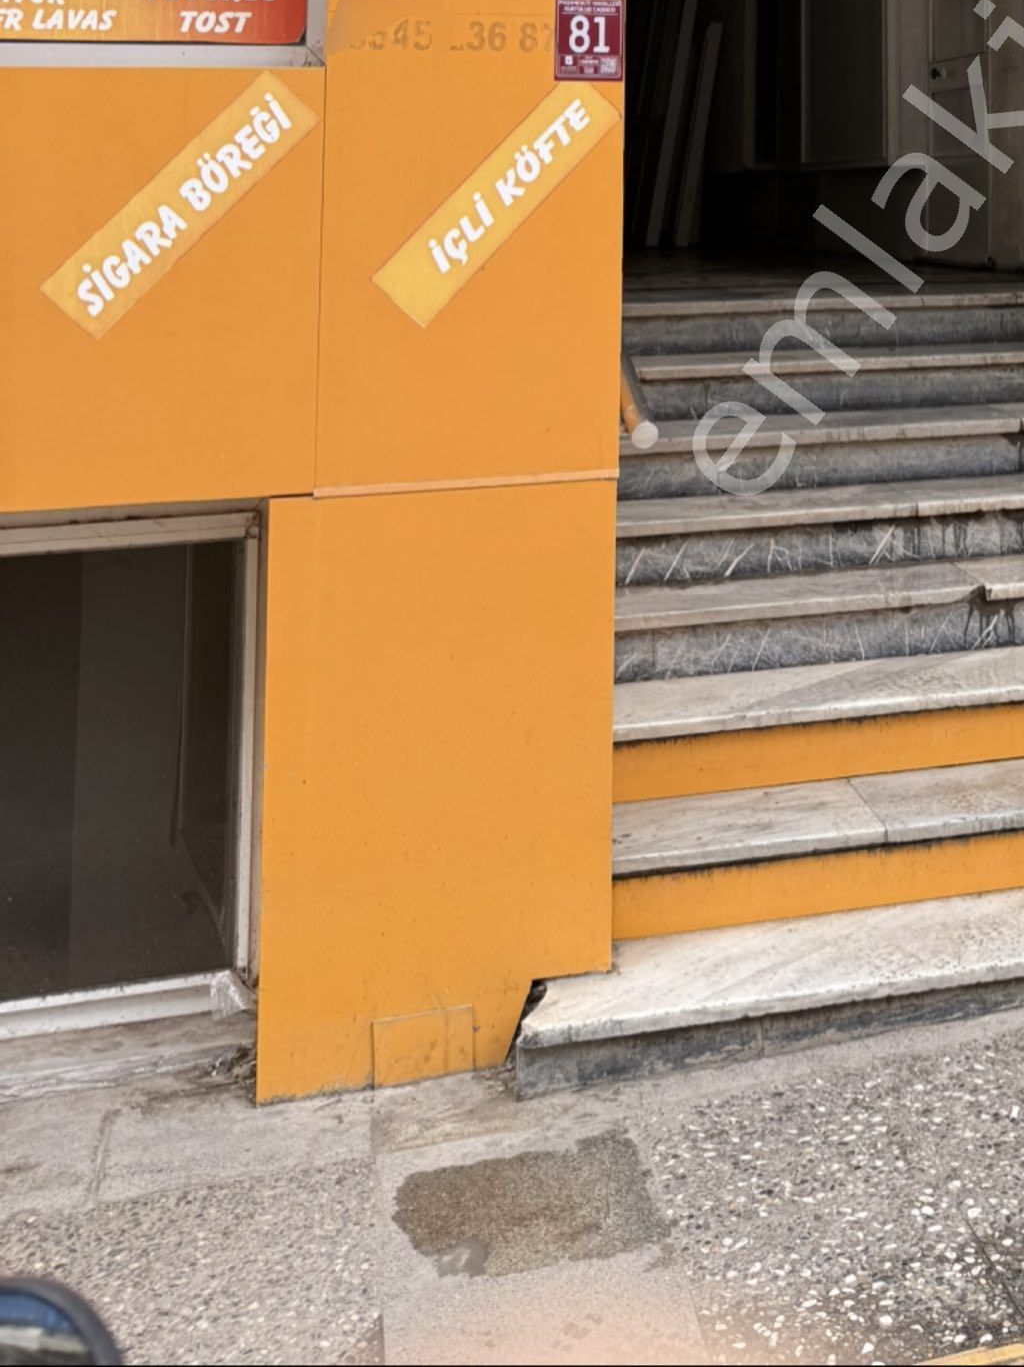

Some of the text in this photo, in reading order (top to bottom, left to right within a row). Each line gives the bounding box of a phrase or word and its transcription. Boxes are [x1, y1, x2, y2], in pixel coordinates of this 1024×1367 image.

[31, 8, 118, 31] LAVAS
[180, 10, 252, 33] TOST
[568, 14, 611, 54] 81
[76, 92, 293, 318] SİGARA BÖREĞİ
[428, 192, 496, 277] İÇLİ
[494, 98, 592, 207] KÖFTE
